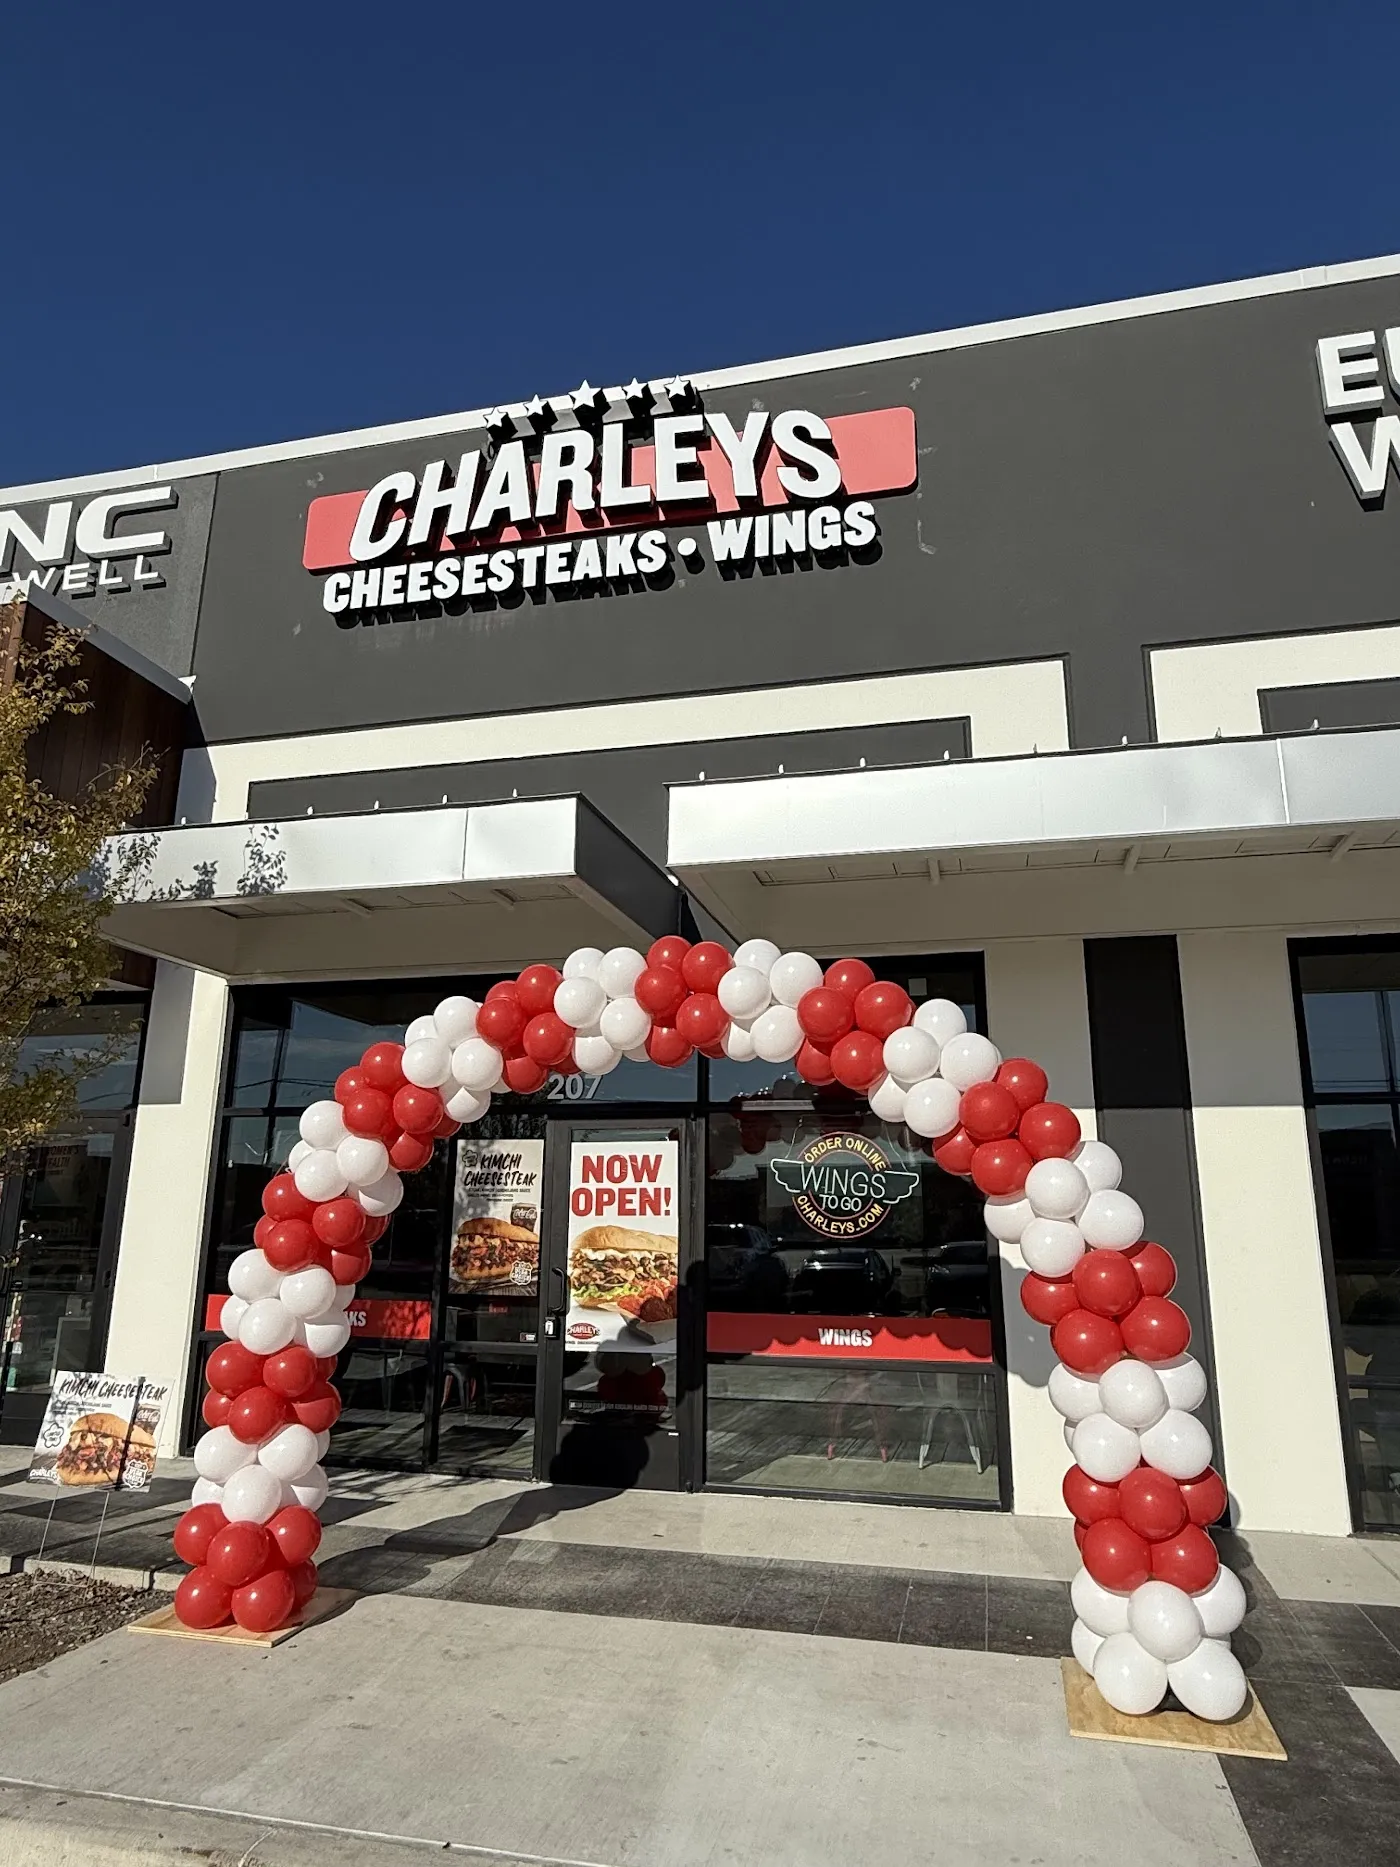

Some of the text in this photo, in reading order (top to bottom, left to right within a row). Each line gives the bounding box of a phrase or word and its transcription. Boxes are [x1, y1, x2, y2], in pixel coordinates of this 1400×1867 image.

[348, 409, 842, 562] CHARLEYS
[322, 500, 877, 613] CHEESESTEAKS WINGS
[547, 1074, 602, 1100] 207
[480, 1153, 522, 1171] KIMCHI
[804, 1136, 887, 1172] ORDER ONLINE
[463, 1171, 537, 1187] CHEESESTEAK
[581, 1154, 663, 1184] NOW
[801, 1164, 887, 1199] WINGS
[571, 1187, 671, 1217] OPEN!
[819, 1194, 862, 1212] TO GO
[818, 1328, 873, 1347] WINGS
[59, 1378, 99, 1398] KIMCHI
